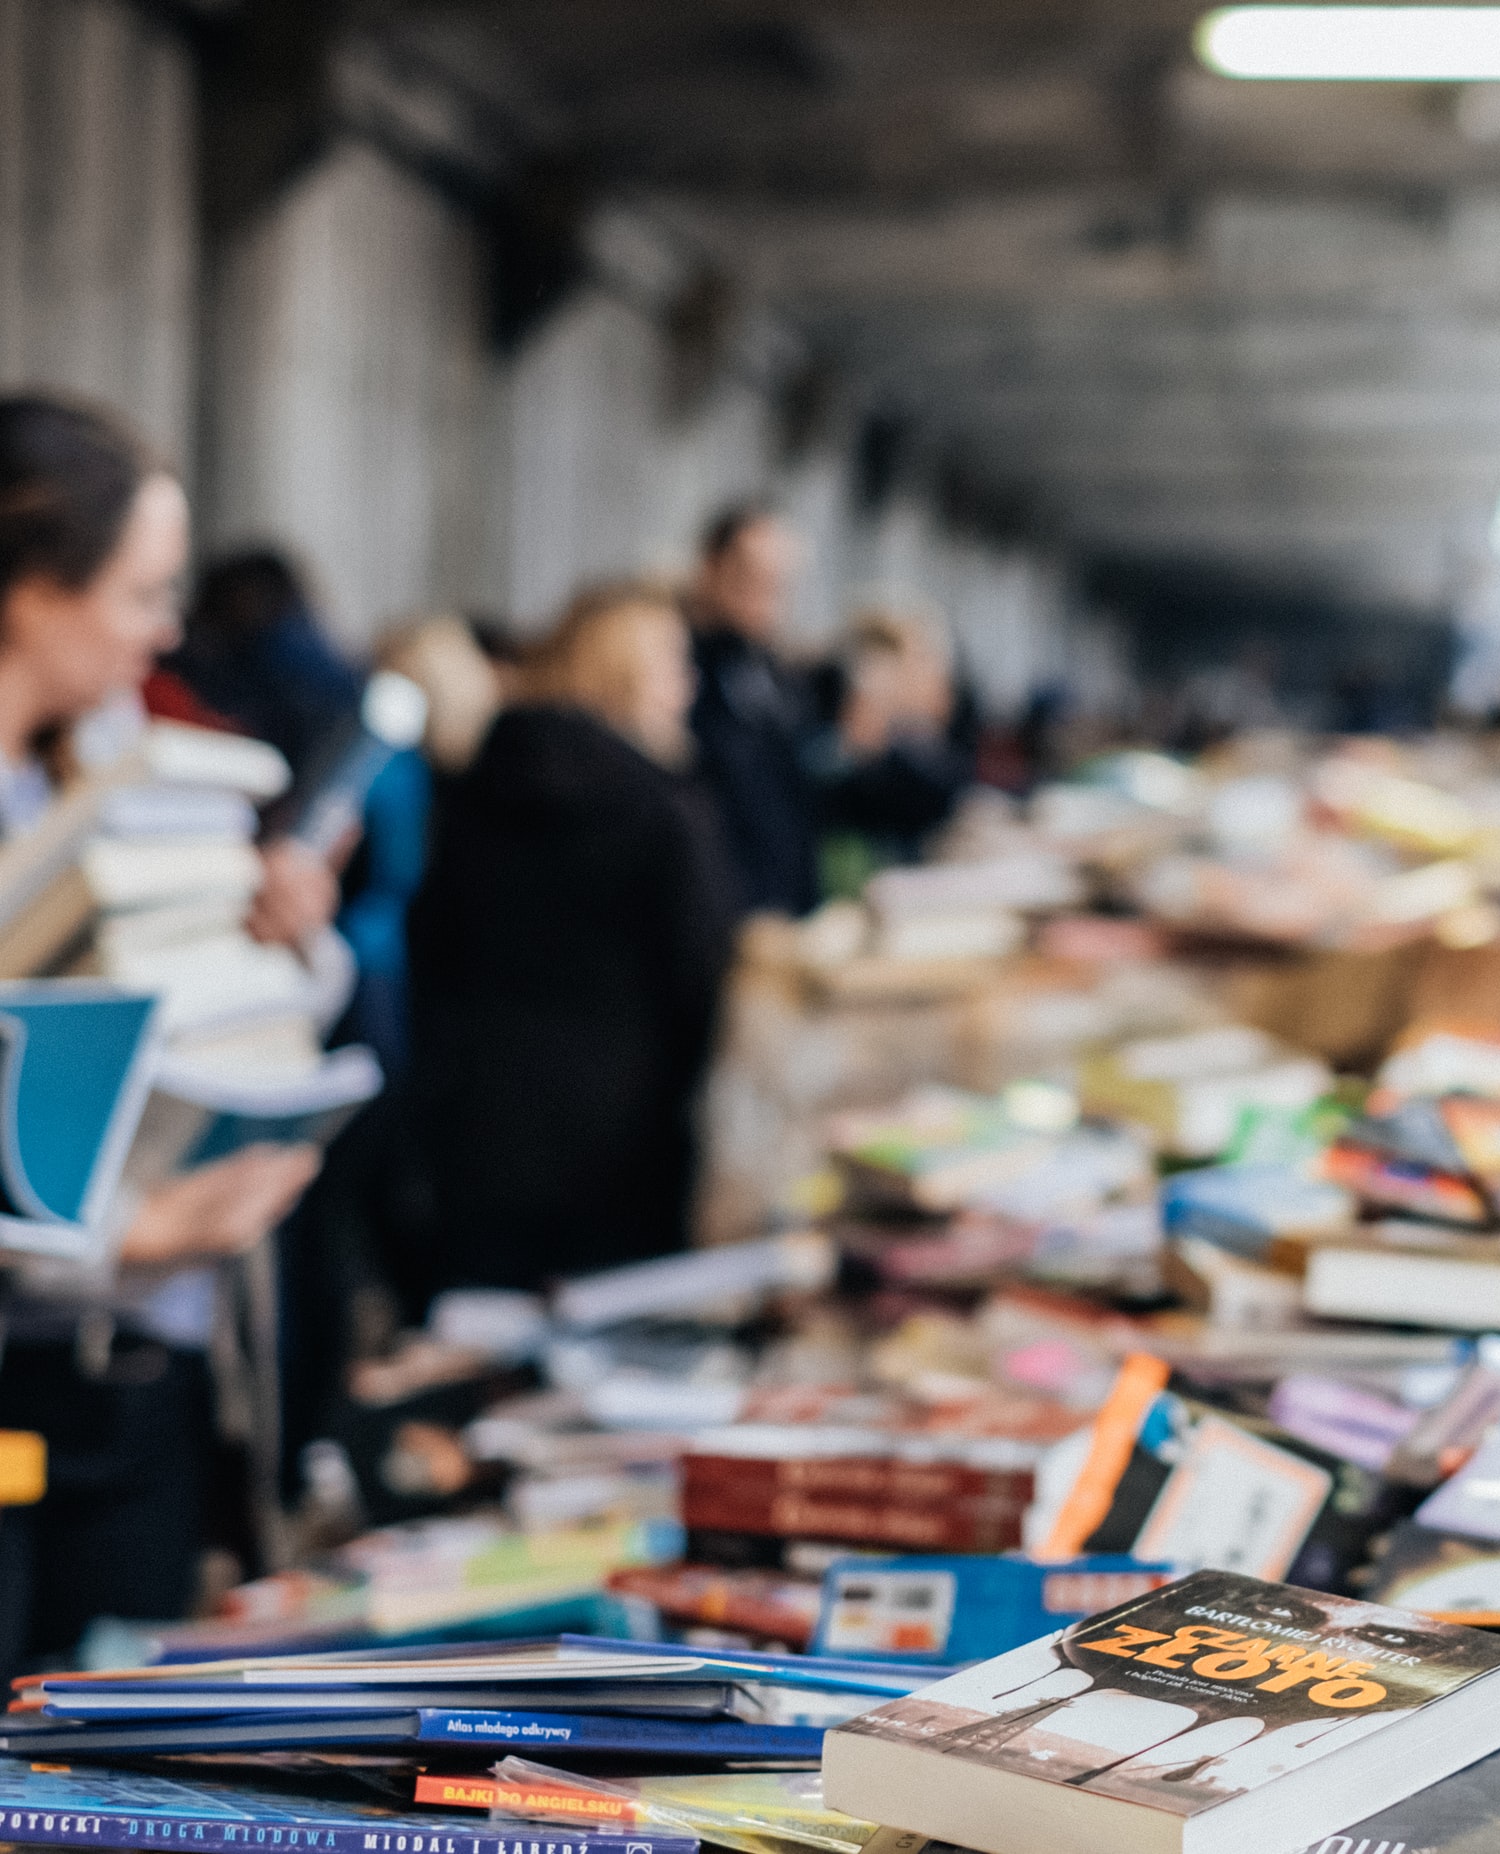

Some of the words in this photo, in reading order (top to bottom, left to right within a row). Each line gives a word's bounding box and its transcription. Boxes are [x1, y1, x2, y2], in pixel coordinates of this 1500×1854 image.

[1079, 1624, 1388, 1709] ZŁOTO
[1173, 1625, 1377, 1680] CZARNE
[1320, 1636, 1422, 1667] RYCHTER
[447, 1719, 473, 1733] Atlas
[474, 1720, 520, 1738] młodego
[521, 1723, 572, 1740] odkrywcy
[443, 1786, 494, 1803] BAJKI
[498, 1790, 522, 1805] PO
[526, 1794, 623, 1815] ANGIELSKU
[128, 1820, 205, 1840] DROGA
[224, 1826, 336, 1847] MIODOWA
[364, 1834, 455, 1853] MIODAL
[473, 1839, 480, 1854] I
